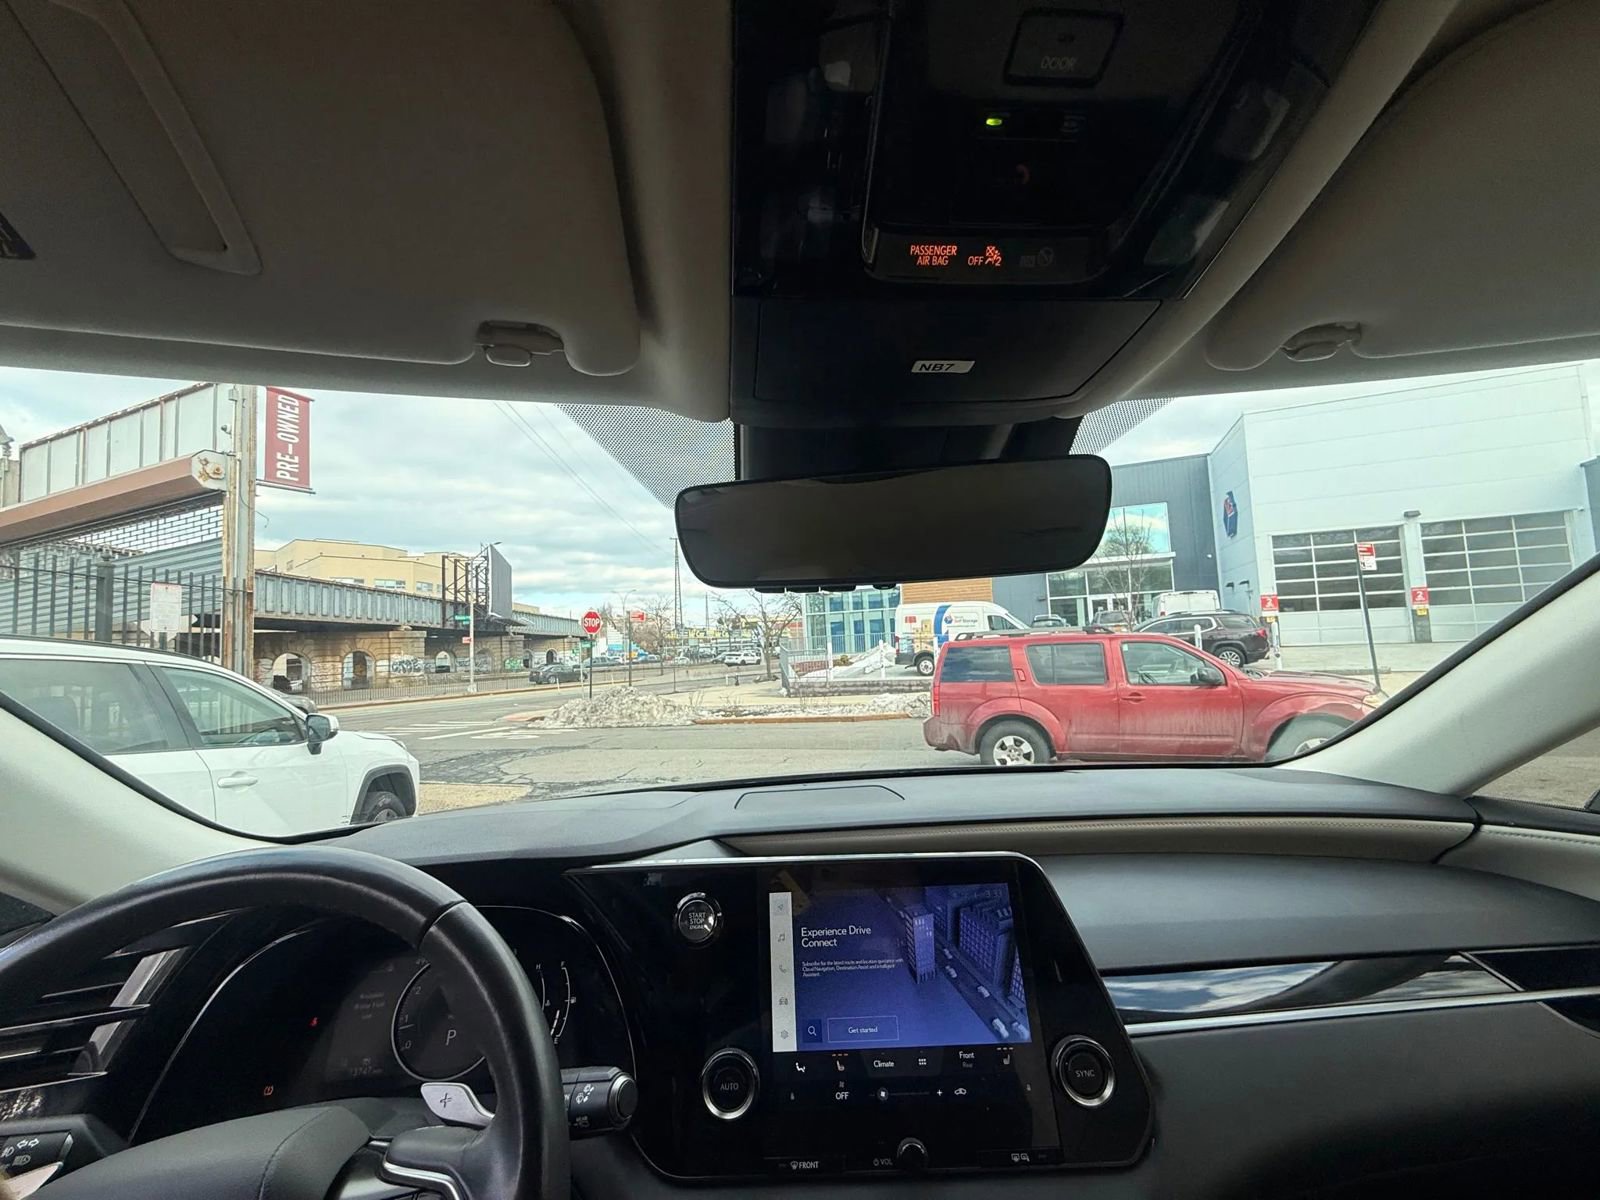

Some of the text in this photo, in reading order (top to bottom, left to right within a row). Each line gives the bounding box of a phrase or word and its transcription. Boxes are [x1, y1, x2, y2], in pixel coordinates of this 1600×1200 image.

[1040, 55, 1077, 72] DOOR
[910, 245, 957, 256] PASSENGER
[917, 256, 949, 266] AIR BAG
[968, 256, 984, 266] OFF
[919, 363, 955, 372] NB7
[276, 394, 300, 481] PRE-OWNED
[584, 618, 600, 628] STOP
[801, 925, 872, 938] Experience Drive
[801, 938, 838, 948] Connect
[848, 1026, 878, 1034] Get started
[445, 1029, 457, 1046] P
[959, 1051, 975, 1060] Front
[873, 1060, 895, 1068] Climate
[1075, 1069, 1096, 1078] SYNC
[720, 1082, 740, 1091] AUTO
[835, 1092, 849, 1100] OFF
[799, 1160, 820, 1169] FRONT
[879, 1158, 893, 1166] VOL
